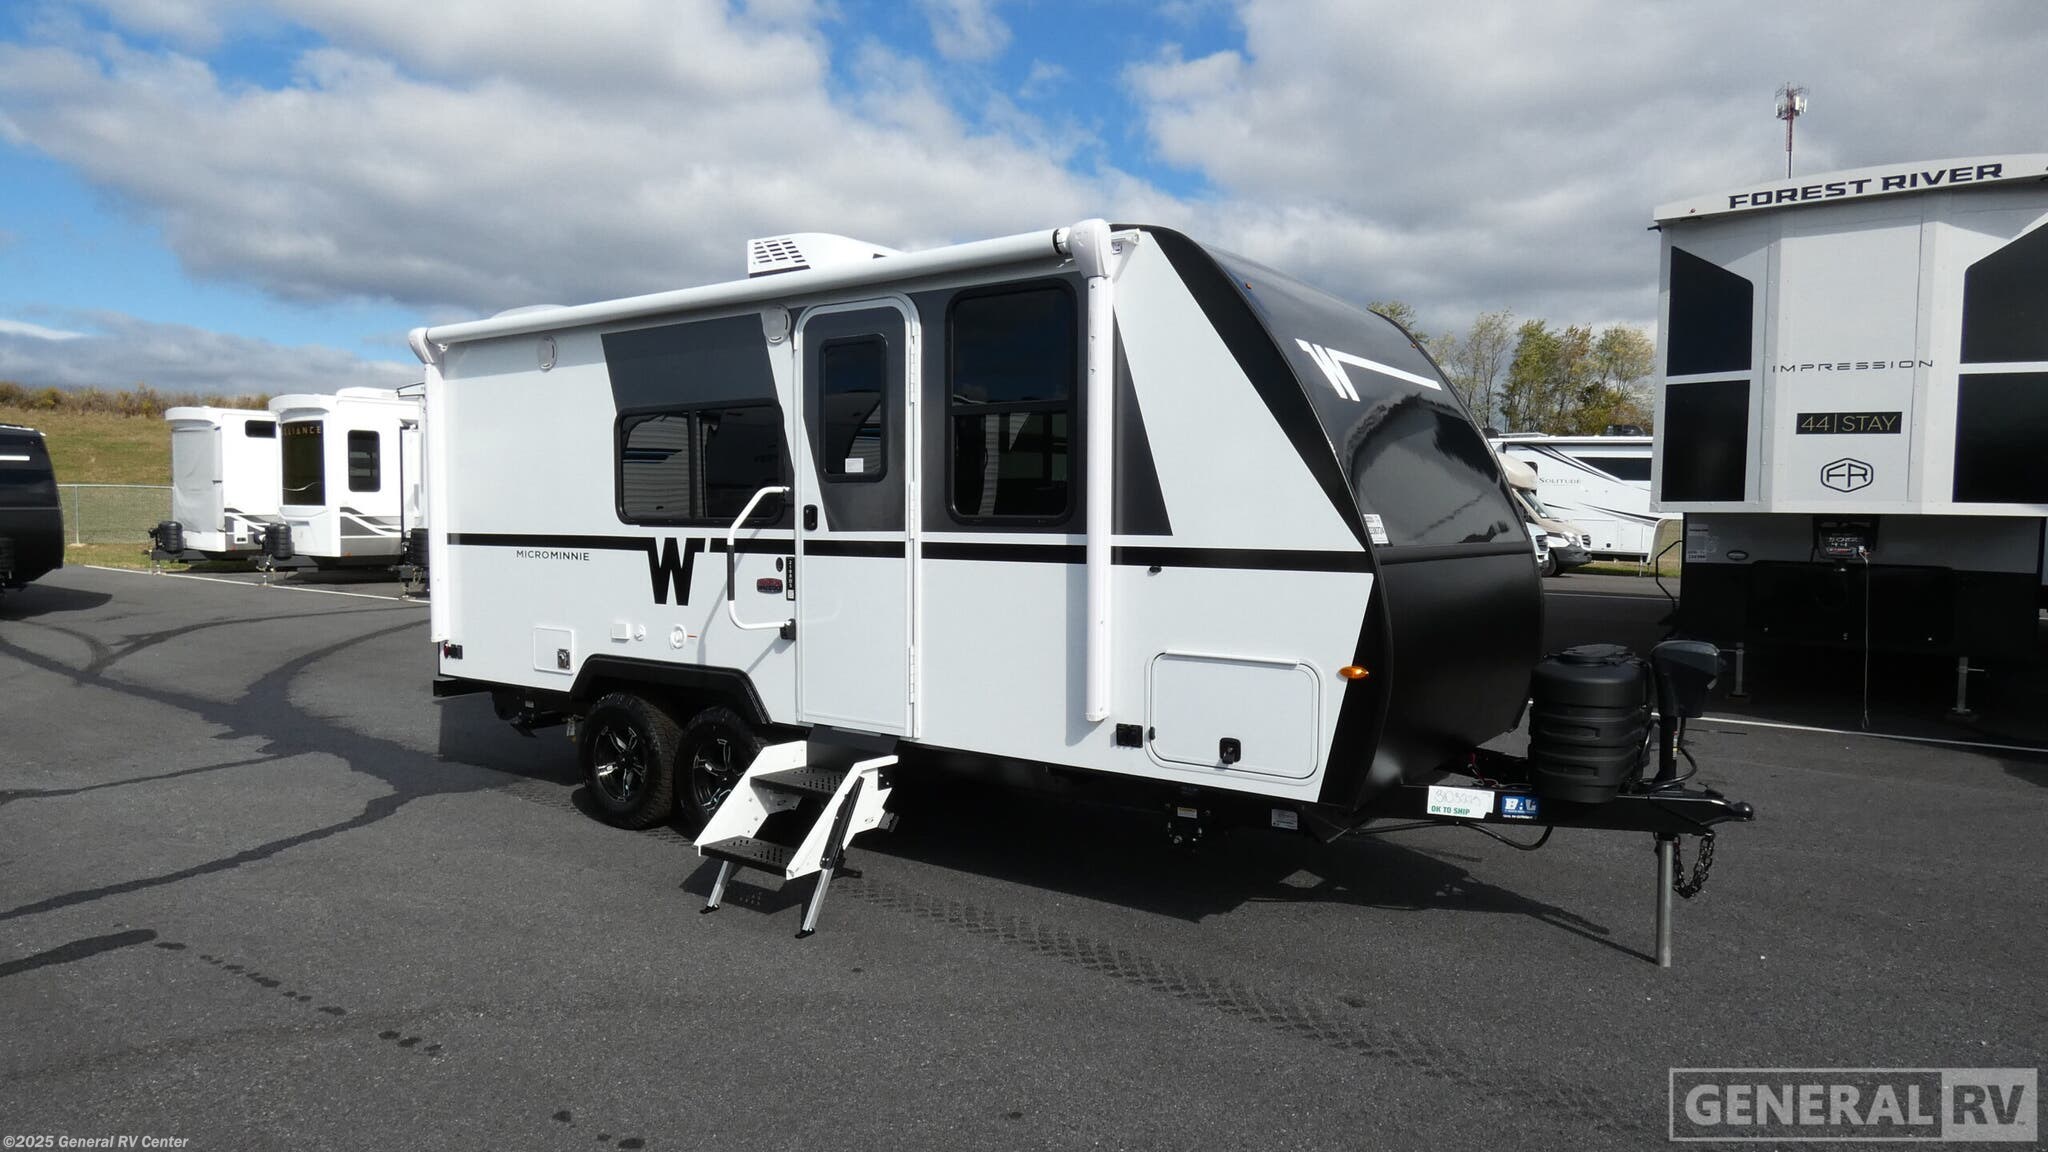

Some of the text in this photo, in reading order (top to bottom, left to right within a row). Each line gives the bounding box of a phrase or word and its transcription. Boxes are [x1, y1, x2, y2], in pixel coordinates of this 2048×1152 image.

[1729, 163, 2003, 210] FOREST RIVER
[1772, 360, 1933, 373] IMPRESSION
[1801, 415, 1897, 431] 44 STAY
[516, 551, 590, 561] MICROMINNIE
[1453, 807, 1470, 815] SHIP
